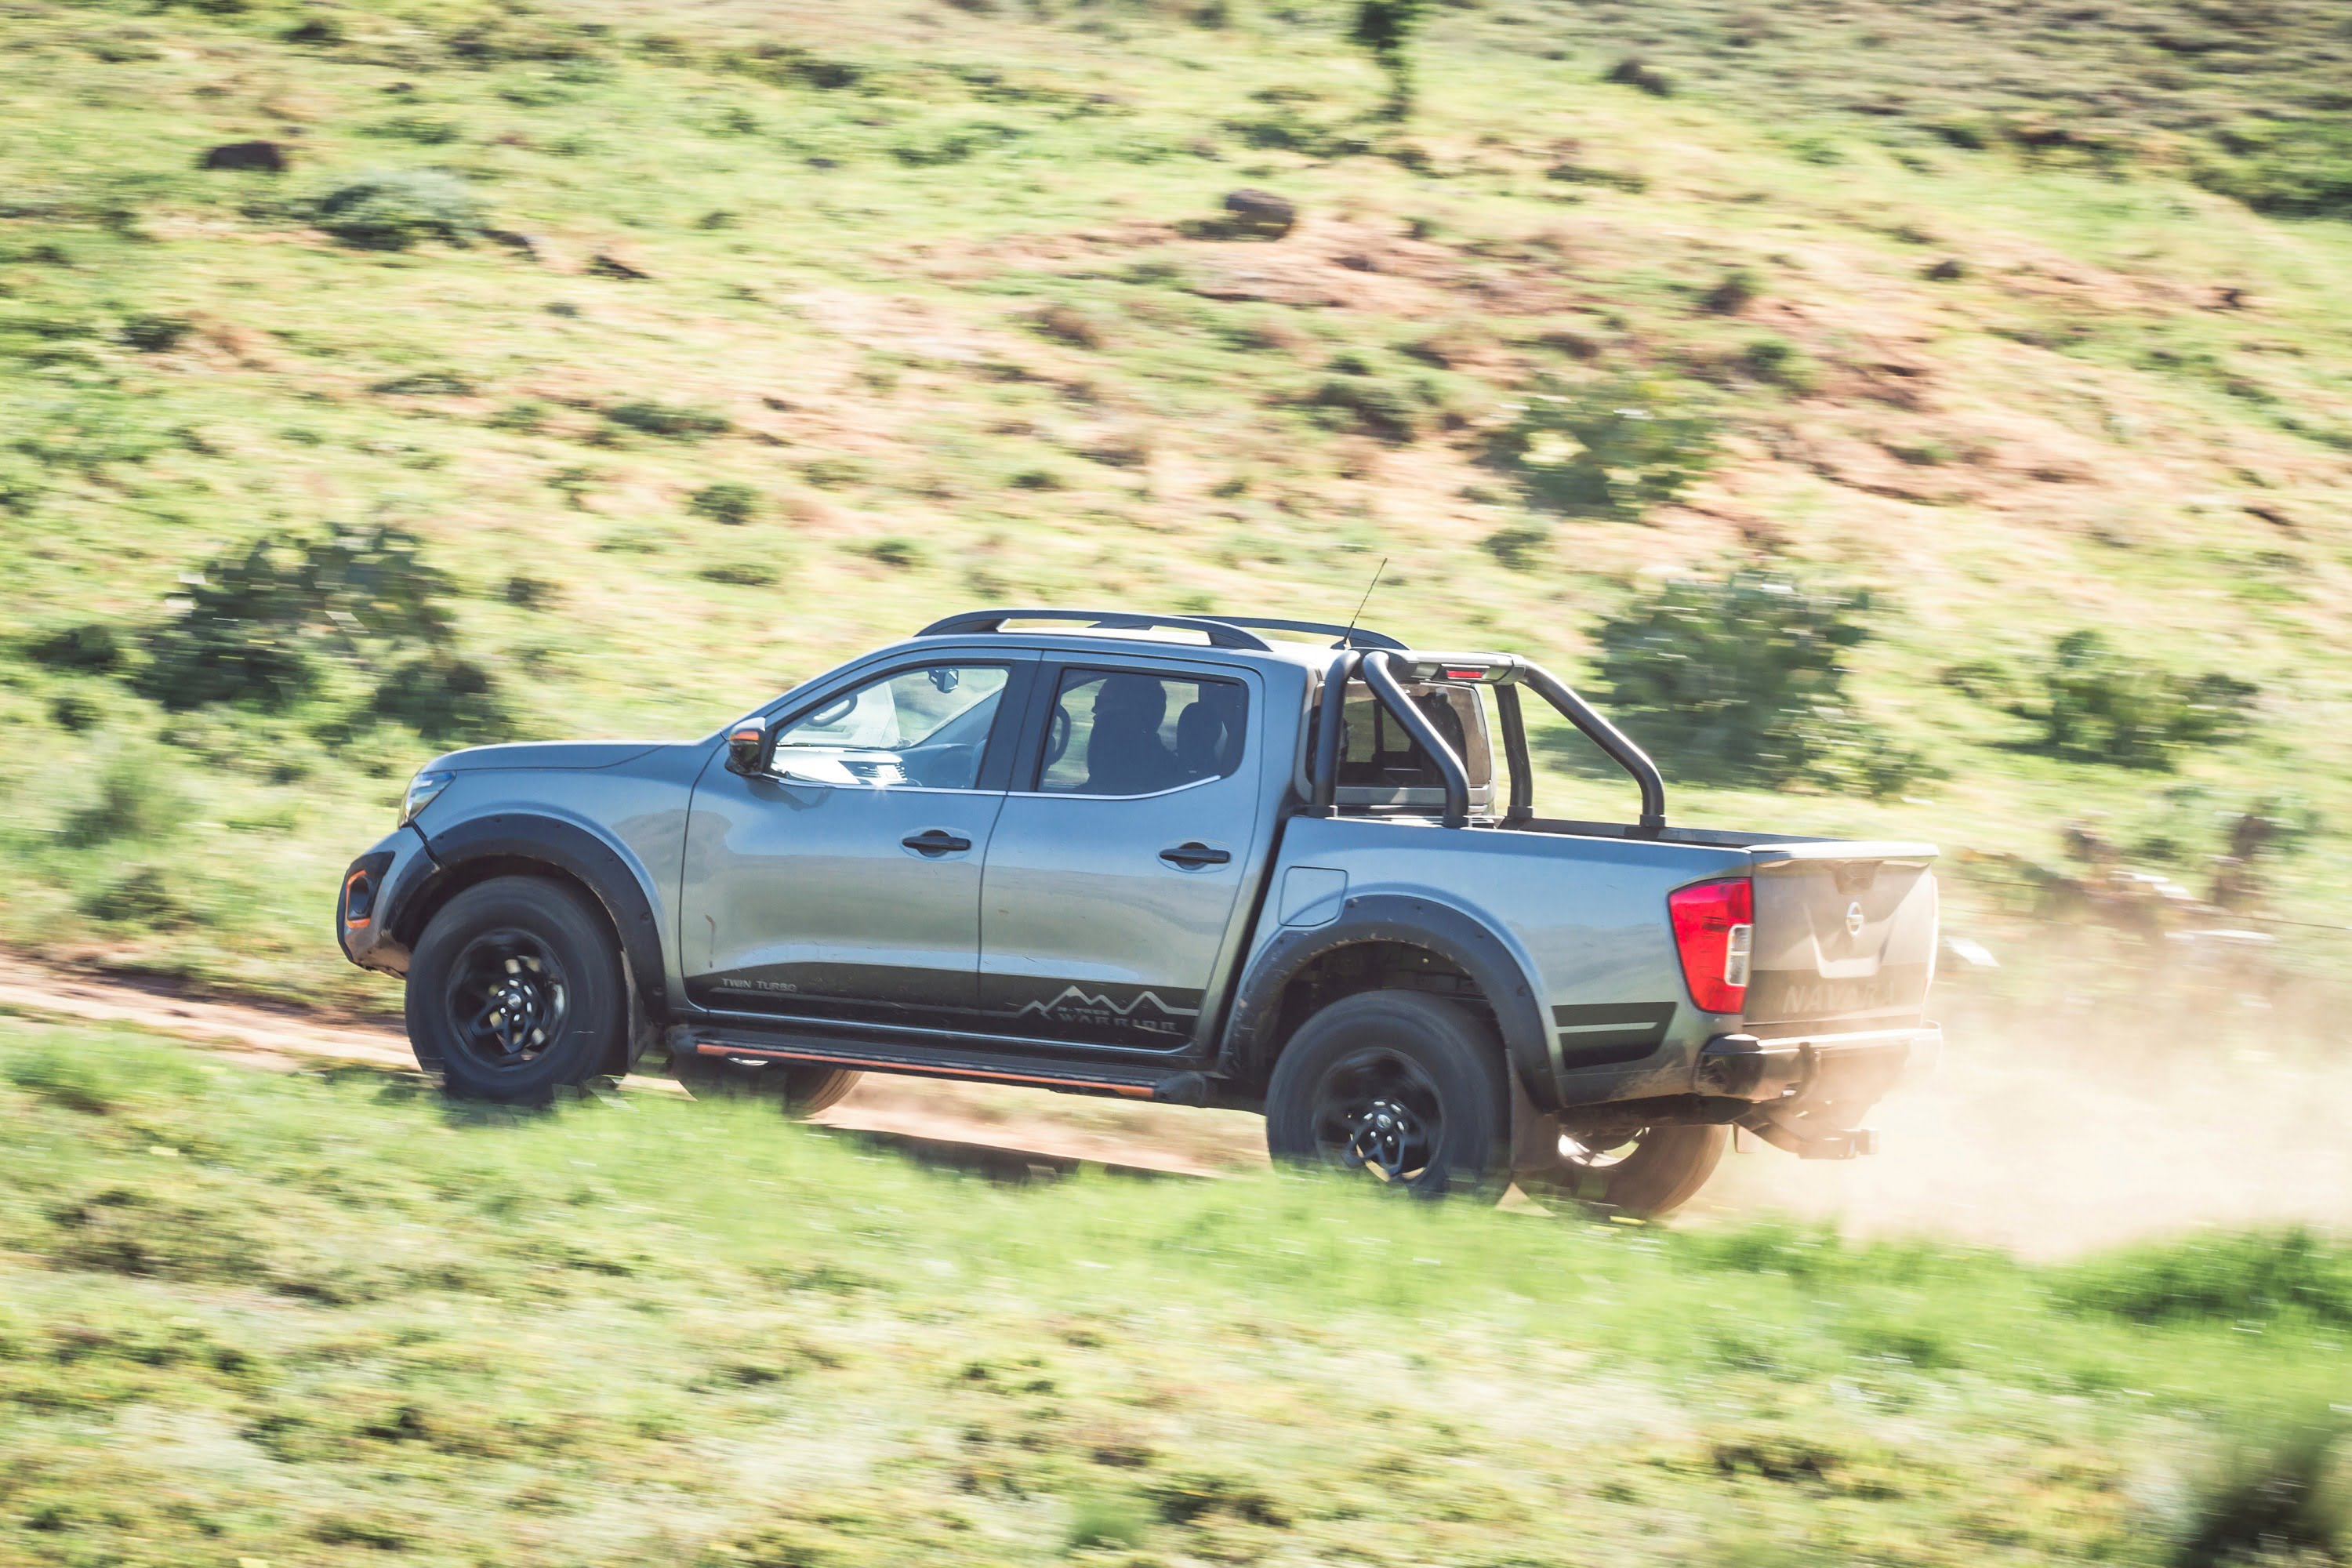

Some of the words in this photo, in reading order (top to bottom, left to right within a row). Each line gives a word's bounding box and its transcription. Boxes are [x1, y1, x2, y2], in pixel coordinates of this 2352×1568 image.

[722, 978, 752, 989] TWIN
[757, 980, 797, 992] TURBO
[1058, 1013, 1177, 1031] WARRIOR
